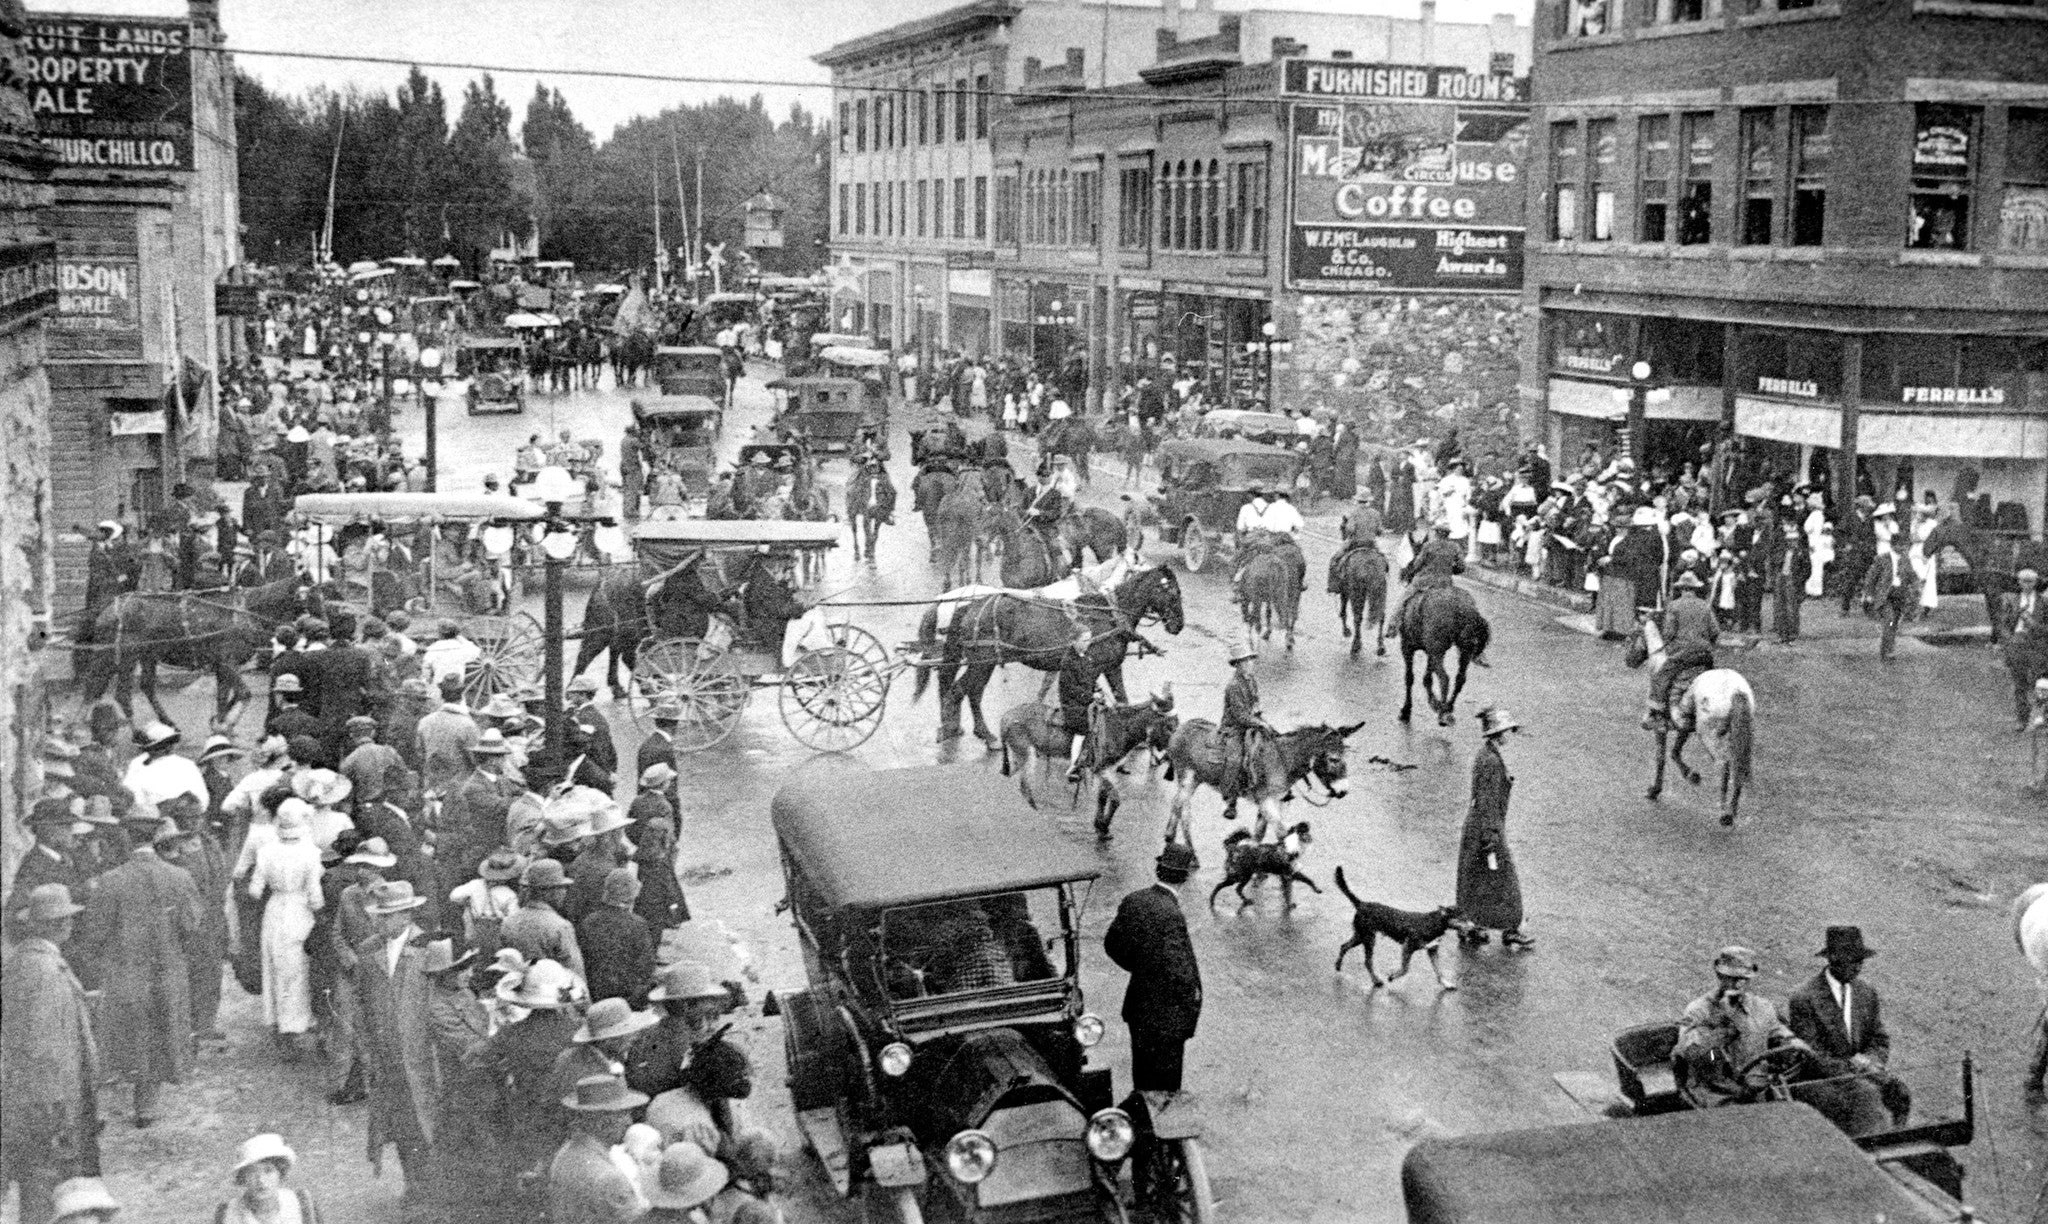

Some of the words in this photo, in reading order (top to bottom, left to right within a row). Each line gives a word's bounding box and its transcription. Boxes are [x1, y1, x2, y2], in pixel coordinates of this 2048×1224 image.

[100, 27, 183, 54] LANDS
[27, 55, 149, 84] ROPERTY
[1306, 67, 1428, 97] FURNISHED
[33, 87, 94, 114] ALE
[1457, 161, 1517, 183] use
[1336, 183, 1476, 219] Coffee
[1436, 230, 1508, 256] Highest
[1330, 248, 1346, 265] &
[1436, 255, 1508, 274] Awards
[1902, 386, 2005, 404] FERRELL'S
